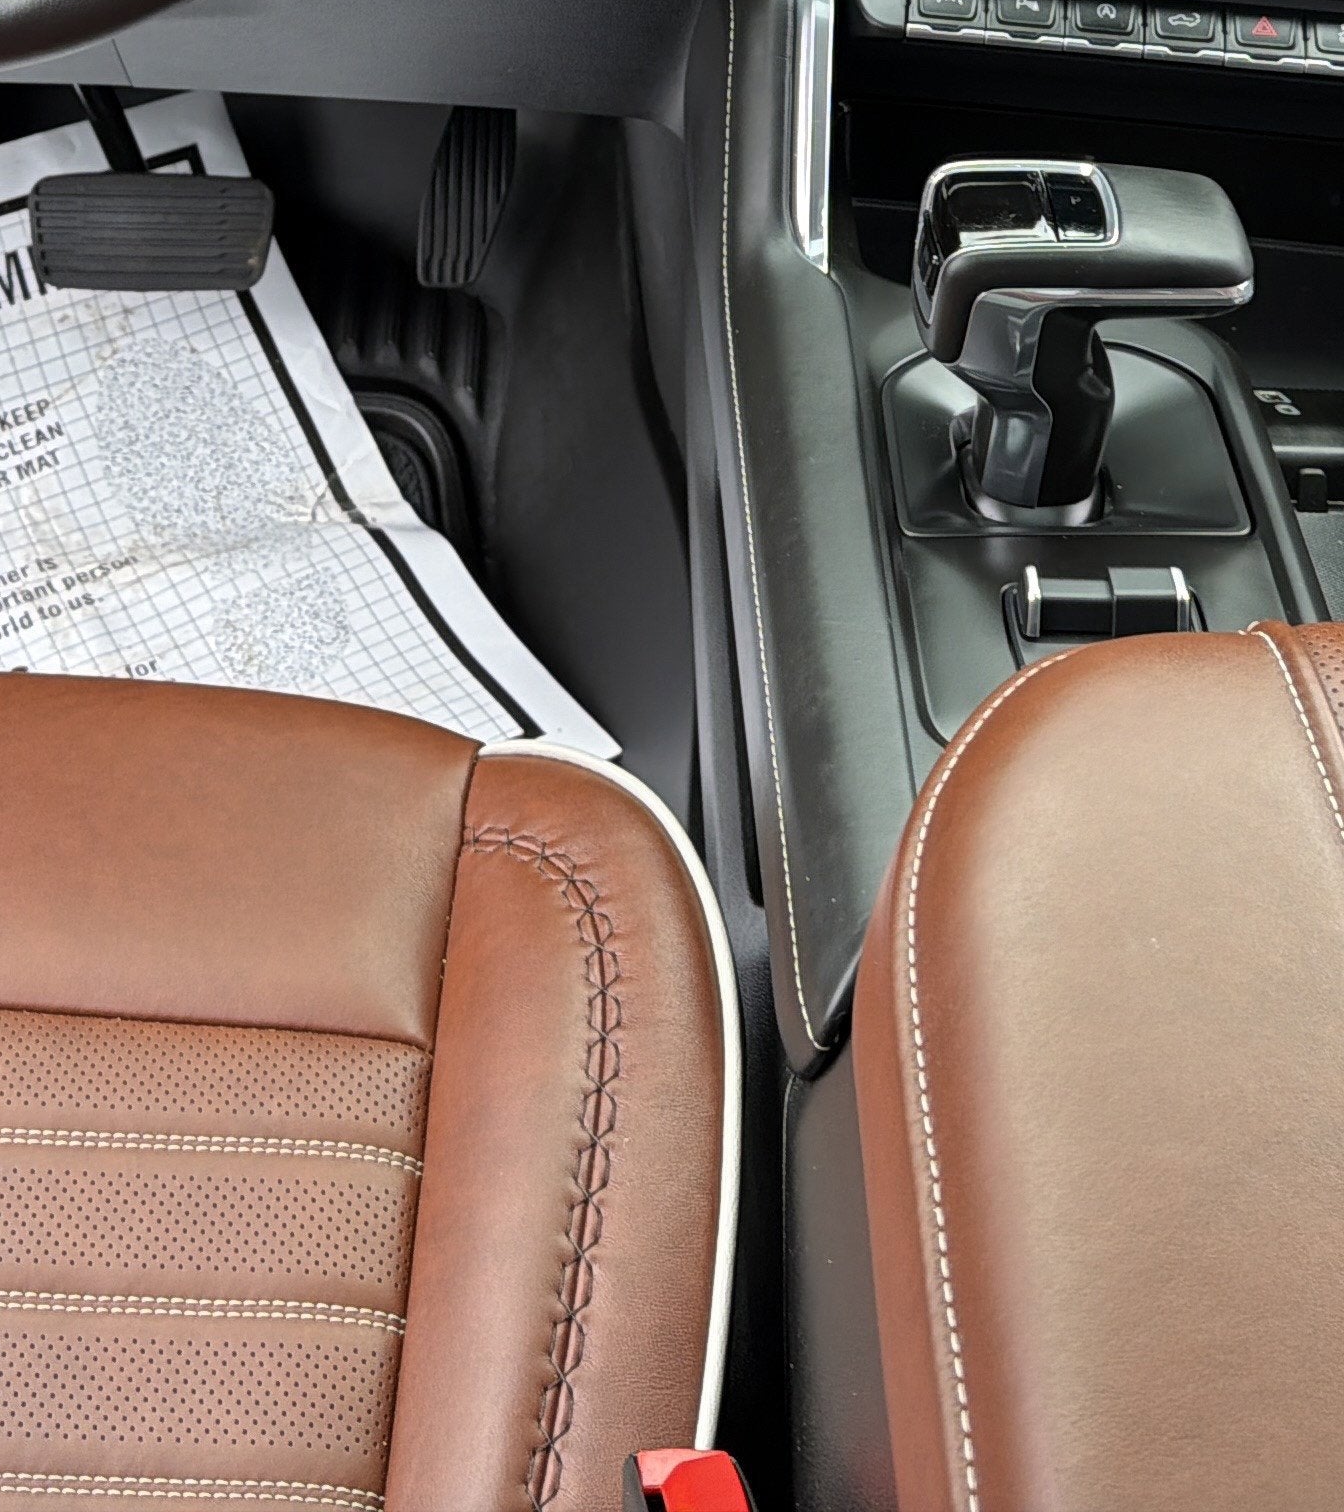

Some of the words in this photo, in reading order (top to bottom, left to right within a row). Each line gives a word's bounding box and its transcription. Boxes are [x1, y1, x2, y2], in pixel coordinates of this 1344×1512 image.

[14, 448, 62, 482] MAT
[62, 554, 139, 592] person
[37, 602, 63, 622] to
[68, 592, 106, 614] us.
